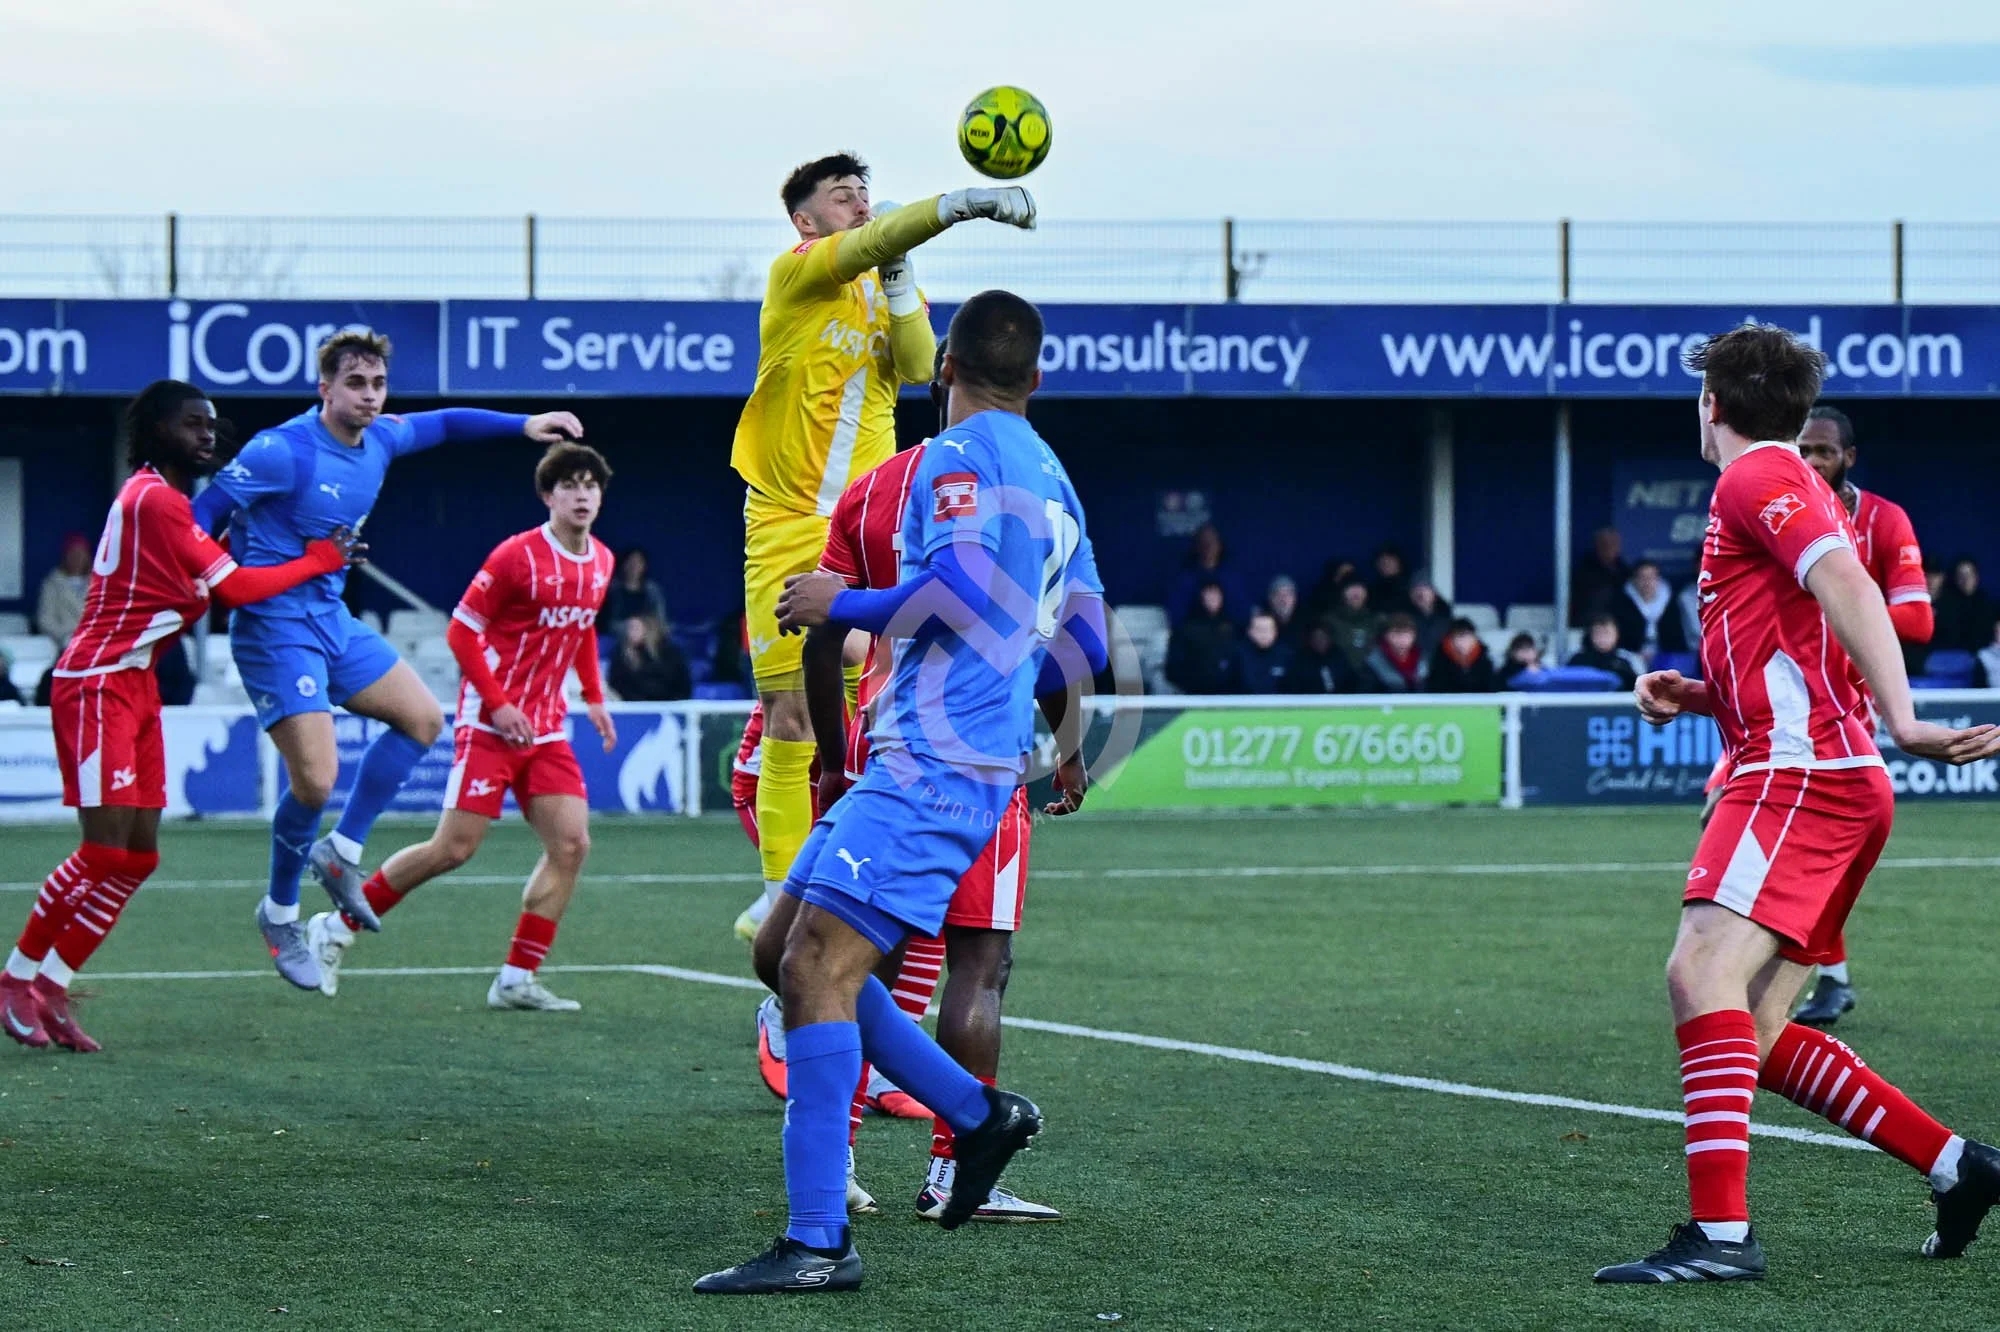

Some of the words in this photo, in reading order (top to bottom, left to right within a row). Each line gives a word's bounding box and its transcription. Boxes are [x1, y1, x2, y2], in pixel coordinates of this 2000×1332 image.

[168, 299, 373, 386] iCor
[467, 316, 520, 371] IT
[542, 316, 736, 373] Service
[1038, 319, 1310, 388] onsultancy
[1182, 725, 1302, 767] 01277
[1312, 722, 1465, 765] 676660
